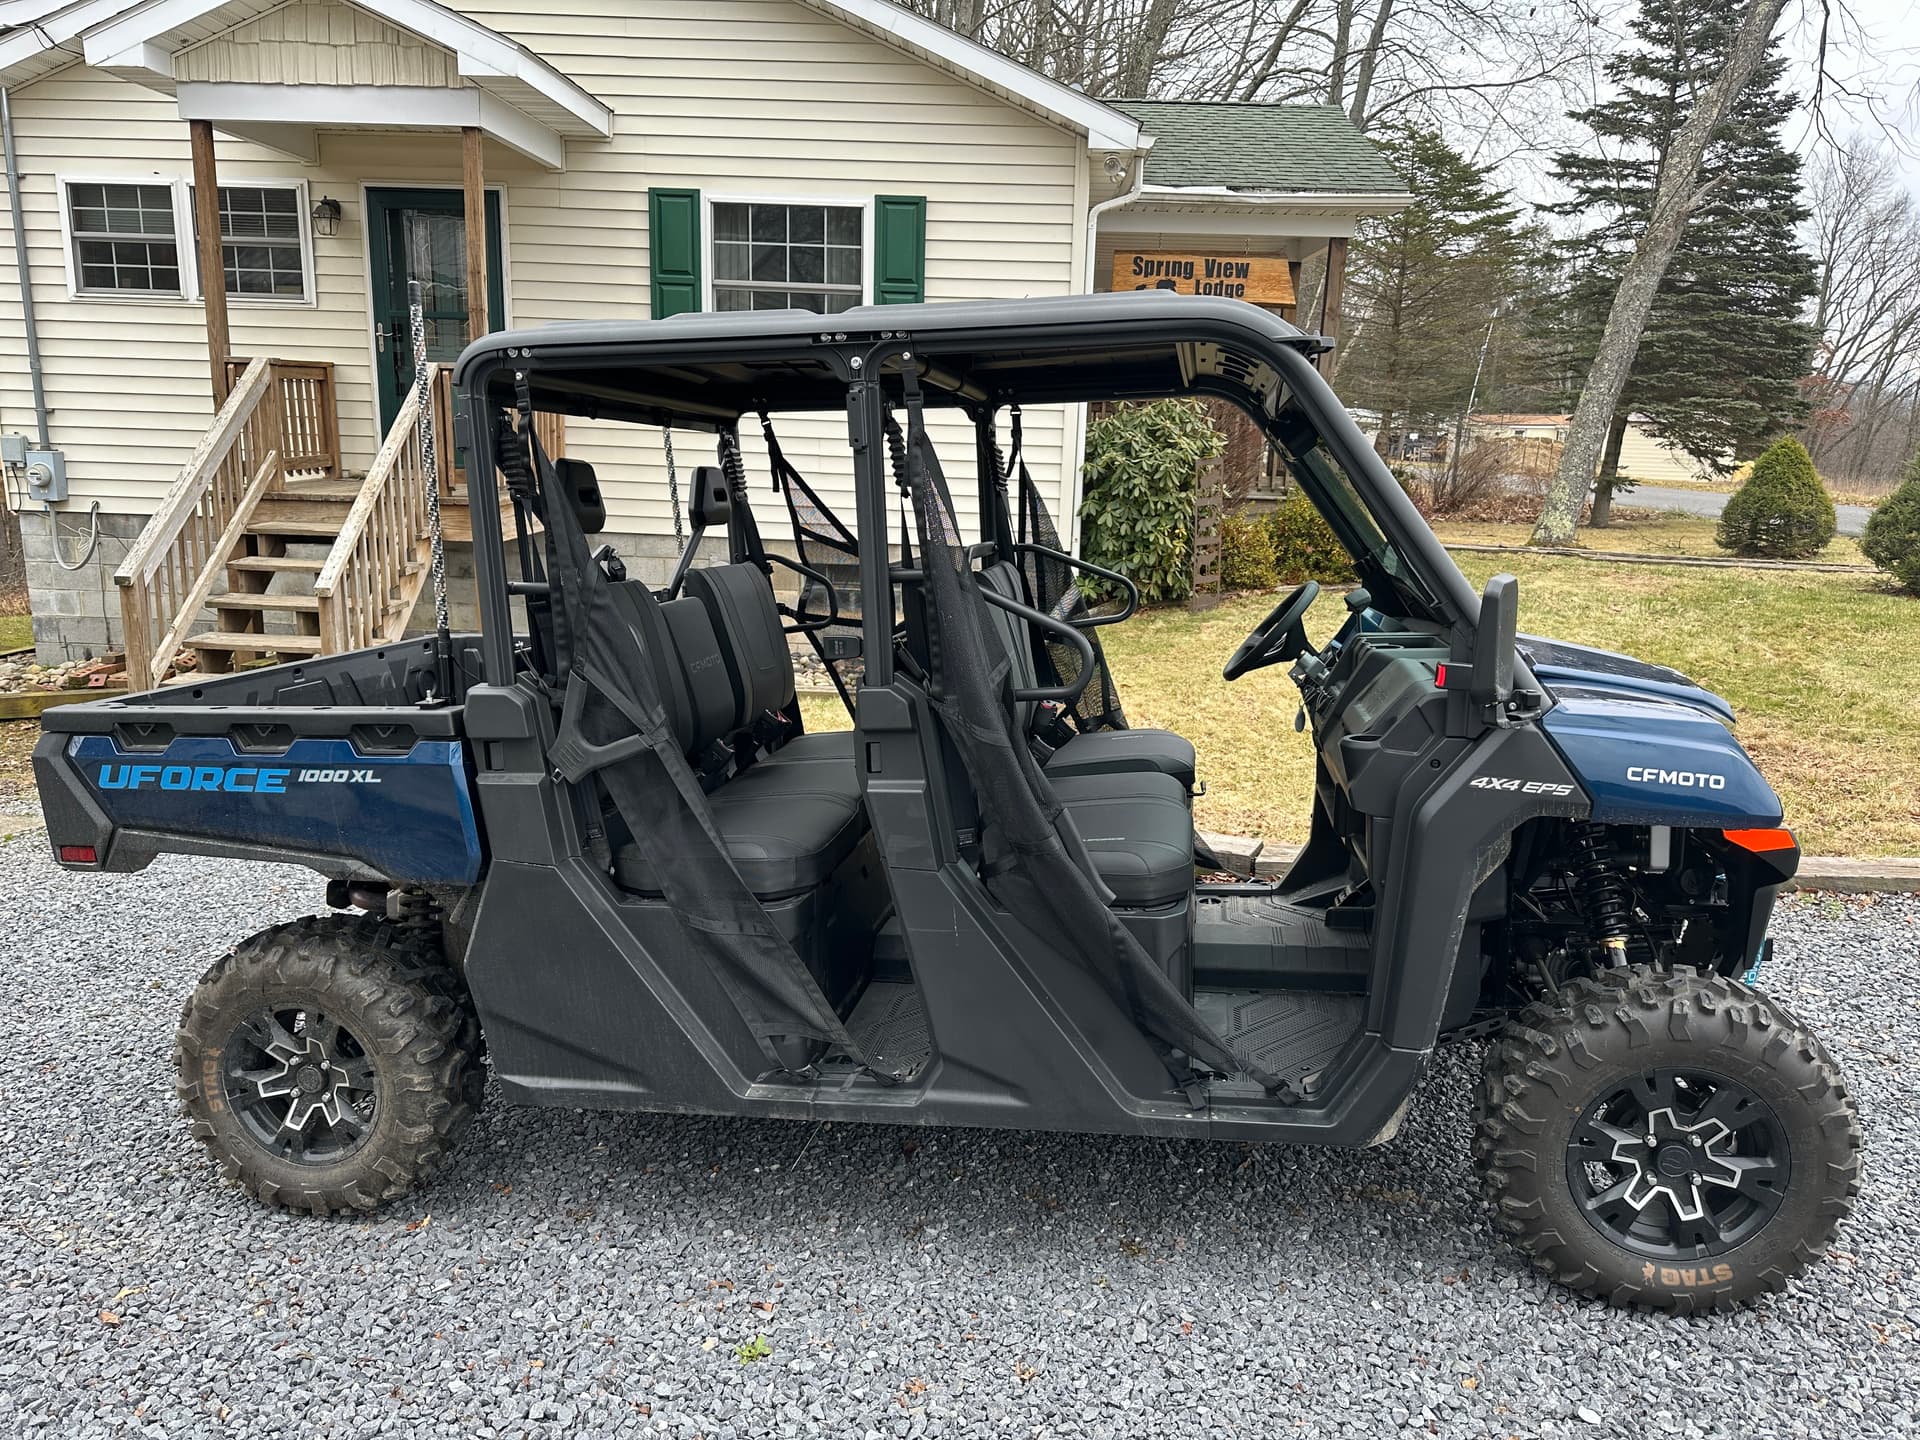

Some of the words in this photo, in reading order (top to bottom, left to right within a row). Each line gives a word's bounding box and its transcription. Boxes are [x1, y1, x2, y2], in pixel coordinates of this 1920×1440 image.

[1132, 255, 1194, 280] Spring
[1204, 258, 1250, 279] View
[1194, 279, 1245, 298] Lodge
[98, 764, 290, 793] UFORCE
[298, 769, 351, 783] 1000
[350, 770, 381, 784] XL
[1469, 776, 1522, 791] 4X4
[1521, 781, 1575, 796] EPS
[1626, 766, 1725, 790] CFMOTO
[1660, 1263, 1734, 1287] STAG
